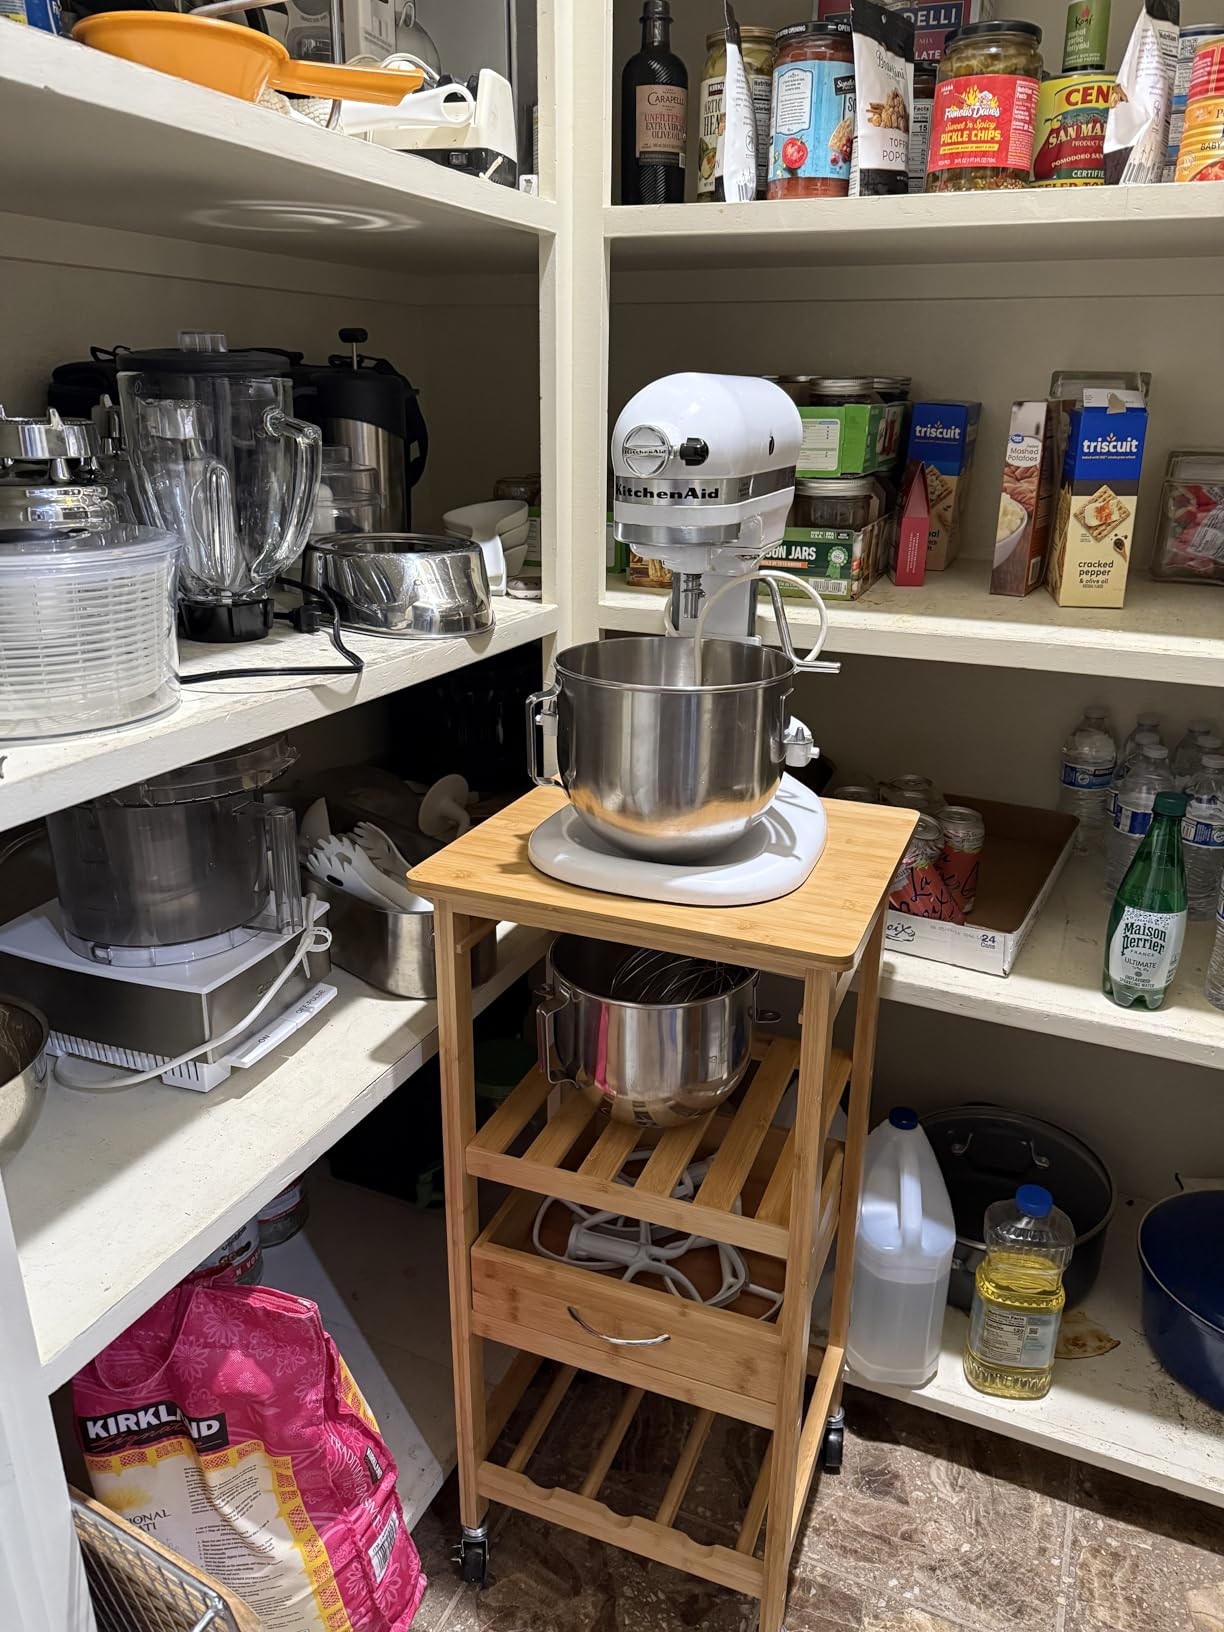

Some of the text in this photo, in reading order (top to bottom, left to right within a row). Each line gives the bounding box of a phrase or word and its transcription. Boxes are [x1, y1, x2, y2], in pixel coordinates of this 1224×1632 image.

[1065, 85, 1110, 107] CEN
[945, 107, 972, 121] Famous
[919, 124, 928, 132] 15
[946, 121, 965, 131] Sweet
[974, 119, 996, 129] Spicy
[940, 130, 1001, 144] PICKLE CHIPS
[1049, 126, 1077, 148] SAN
[1200, 141, 1222, 151] BABY
[1051, 153, 1090, 168] POMODORO
[915, 424, 960, 439] triscuit
[1010, 447, 1039, 455] Mashed
[1083, 437, 1138, 453] triscuit
[615, 482, 719, 499] KitchenAid
[788, 545, 816, 560] JARS
[1078, 560, 1114, 568] cracked
[980, 934, 996, 944] 24
[1123, 922, 1166, 942] Maison
[1131, 949, 1155, 957] FRANCE
[1124, 957, 1157, 968] ULTIMATE
[258, 1034, 271, 1044] ON
